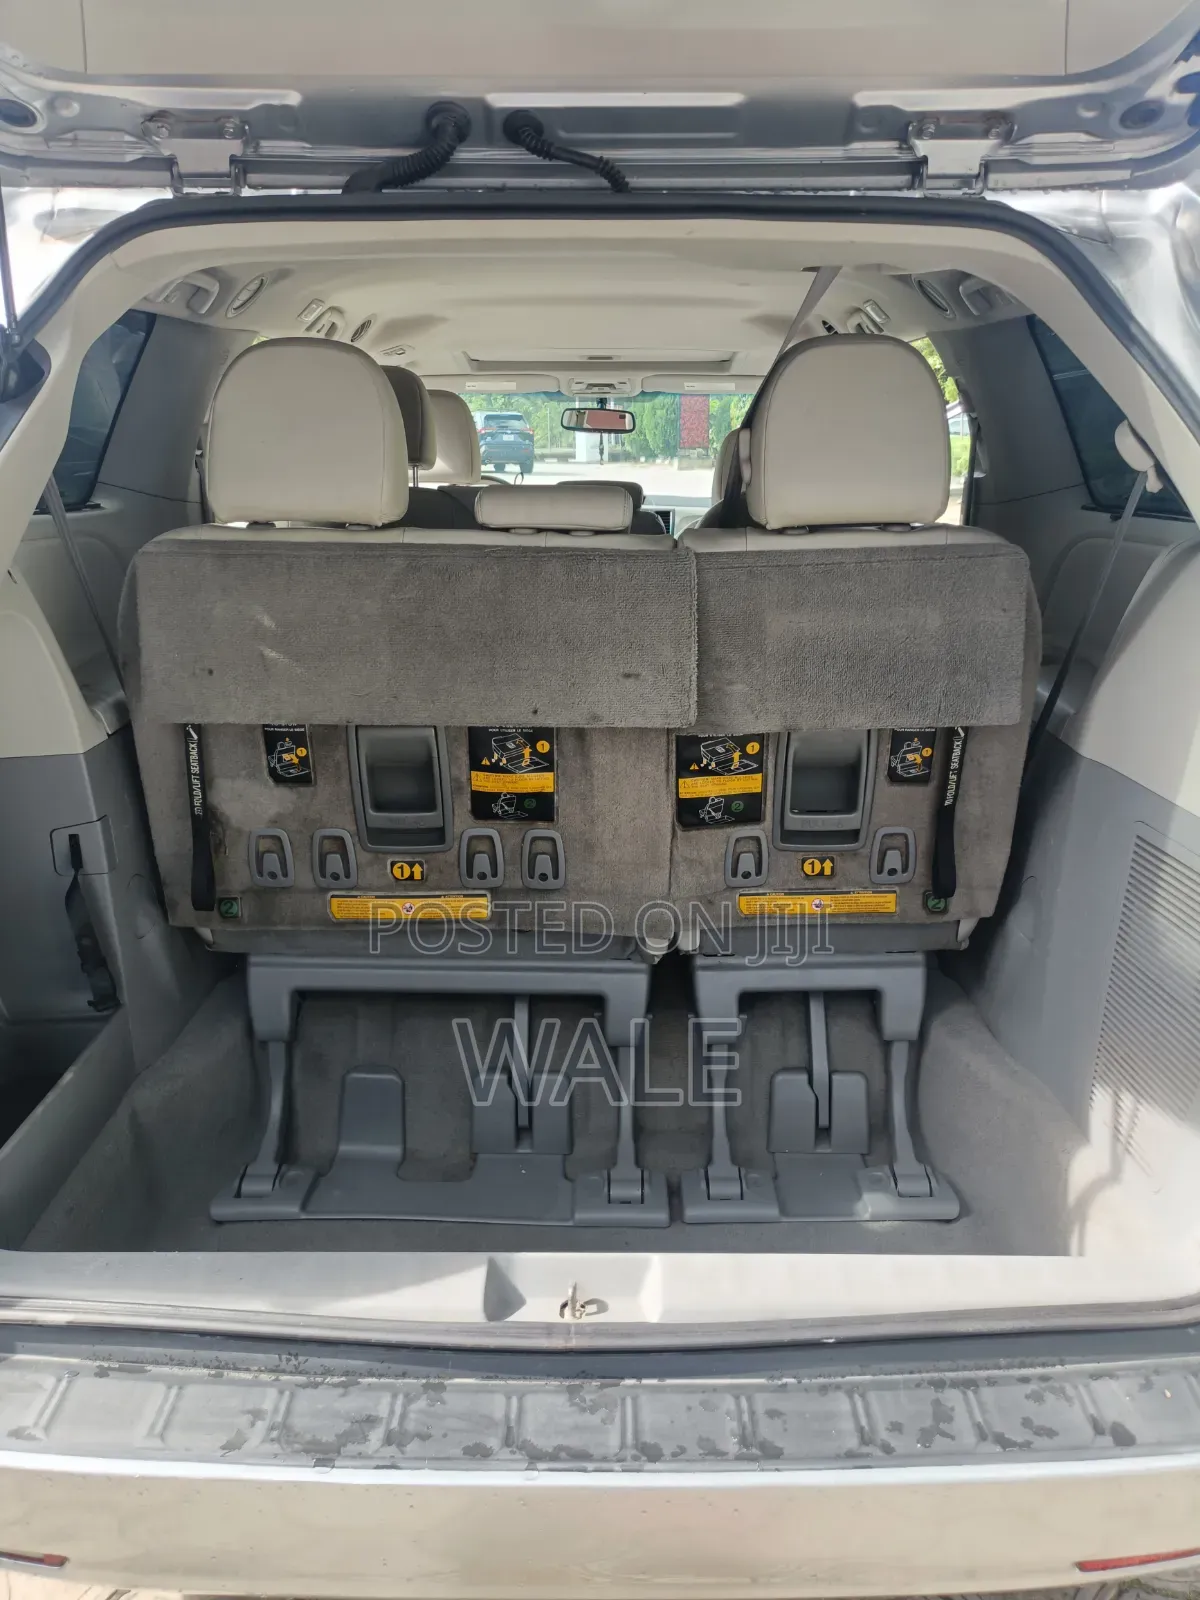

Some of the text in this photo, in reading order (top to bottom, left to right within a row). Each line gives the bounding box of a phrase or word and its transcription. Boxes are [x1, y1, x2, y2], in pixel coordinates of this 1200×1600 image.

[188, 742, 200, 774] SEATBACK
[950, 739, 963, 770] SEATBACK
[191, 775, 203, 806] FOLD/LIFT
[223, 901, 234, 915] 2
